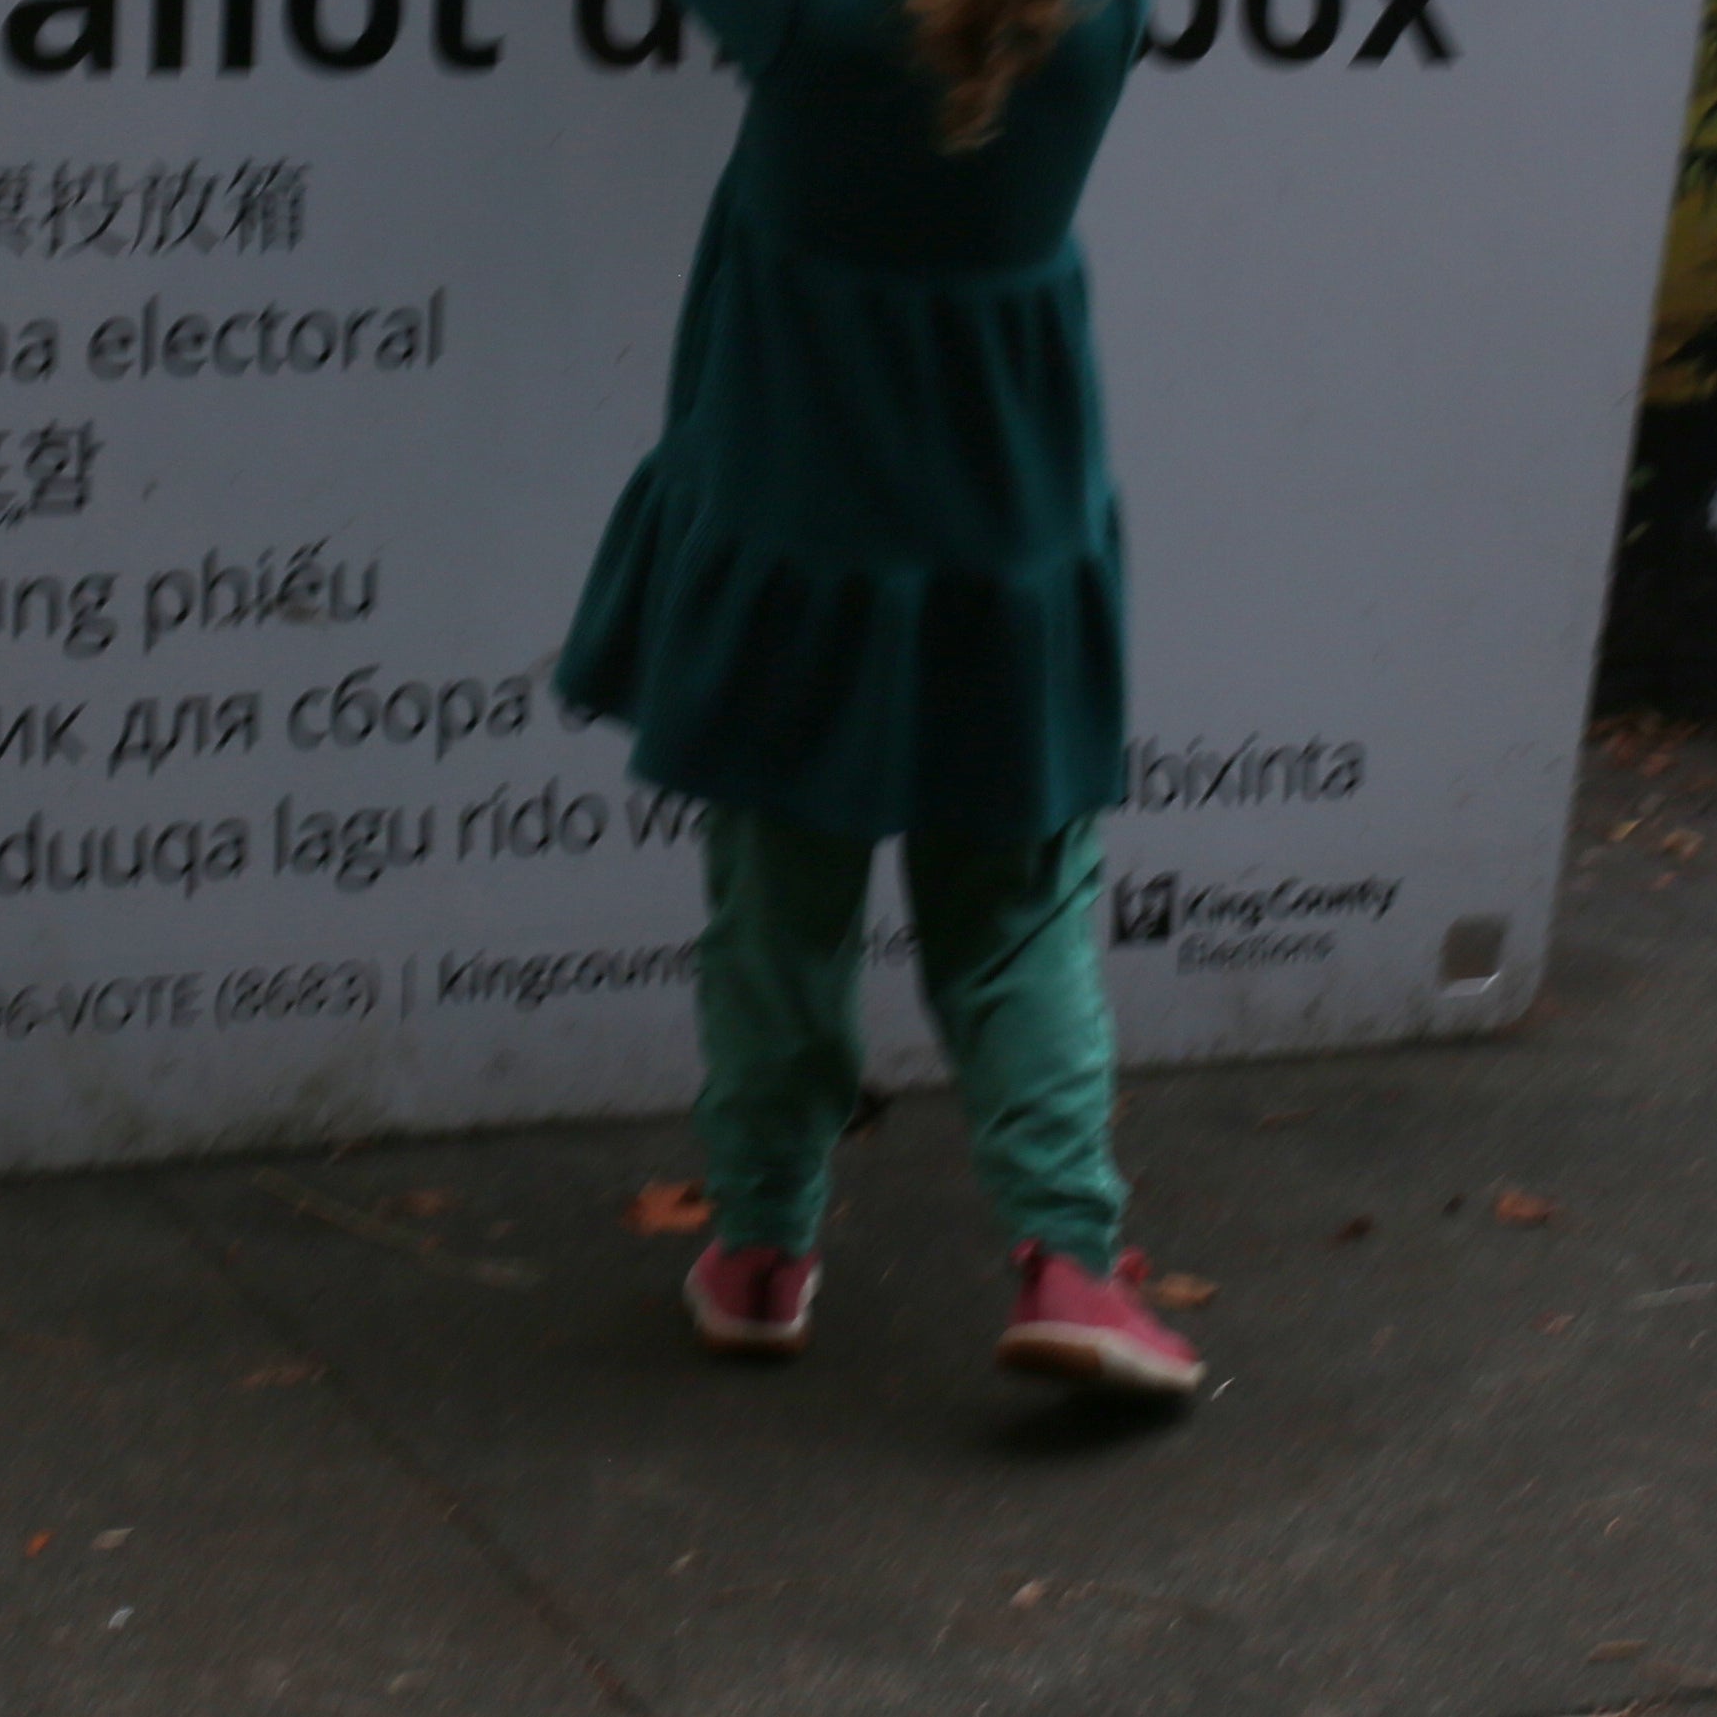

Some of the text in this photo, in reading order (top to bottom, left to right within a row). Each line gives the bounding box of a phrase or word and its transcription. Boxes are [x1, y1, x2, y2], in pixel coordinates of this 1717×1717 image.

[87, 288, 447, 378] electoral
[142, 536, 379, 654] phiếu
[109, 690, 259, 776] для
[287, 665, 532, 759] сбора
[273, 794, 432, 890] lagu
[457, 782, 609, 861] rido
[214, 961, 382, 1031] (8683)
